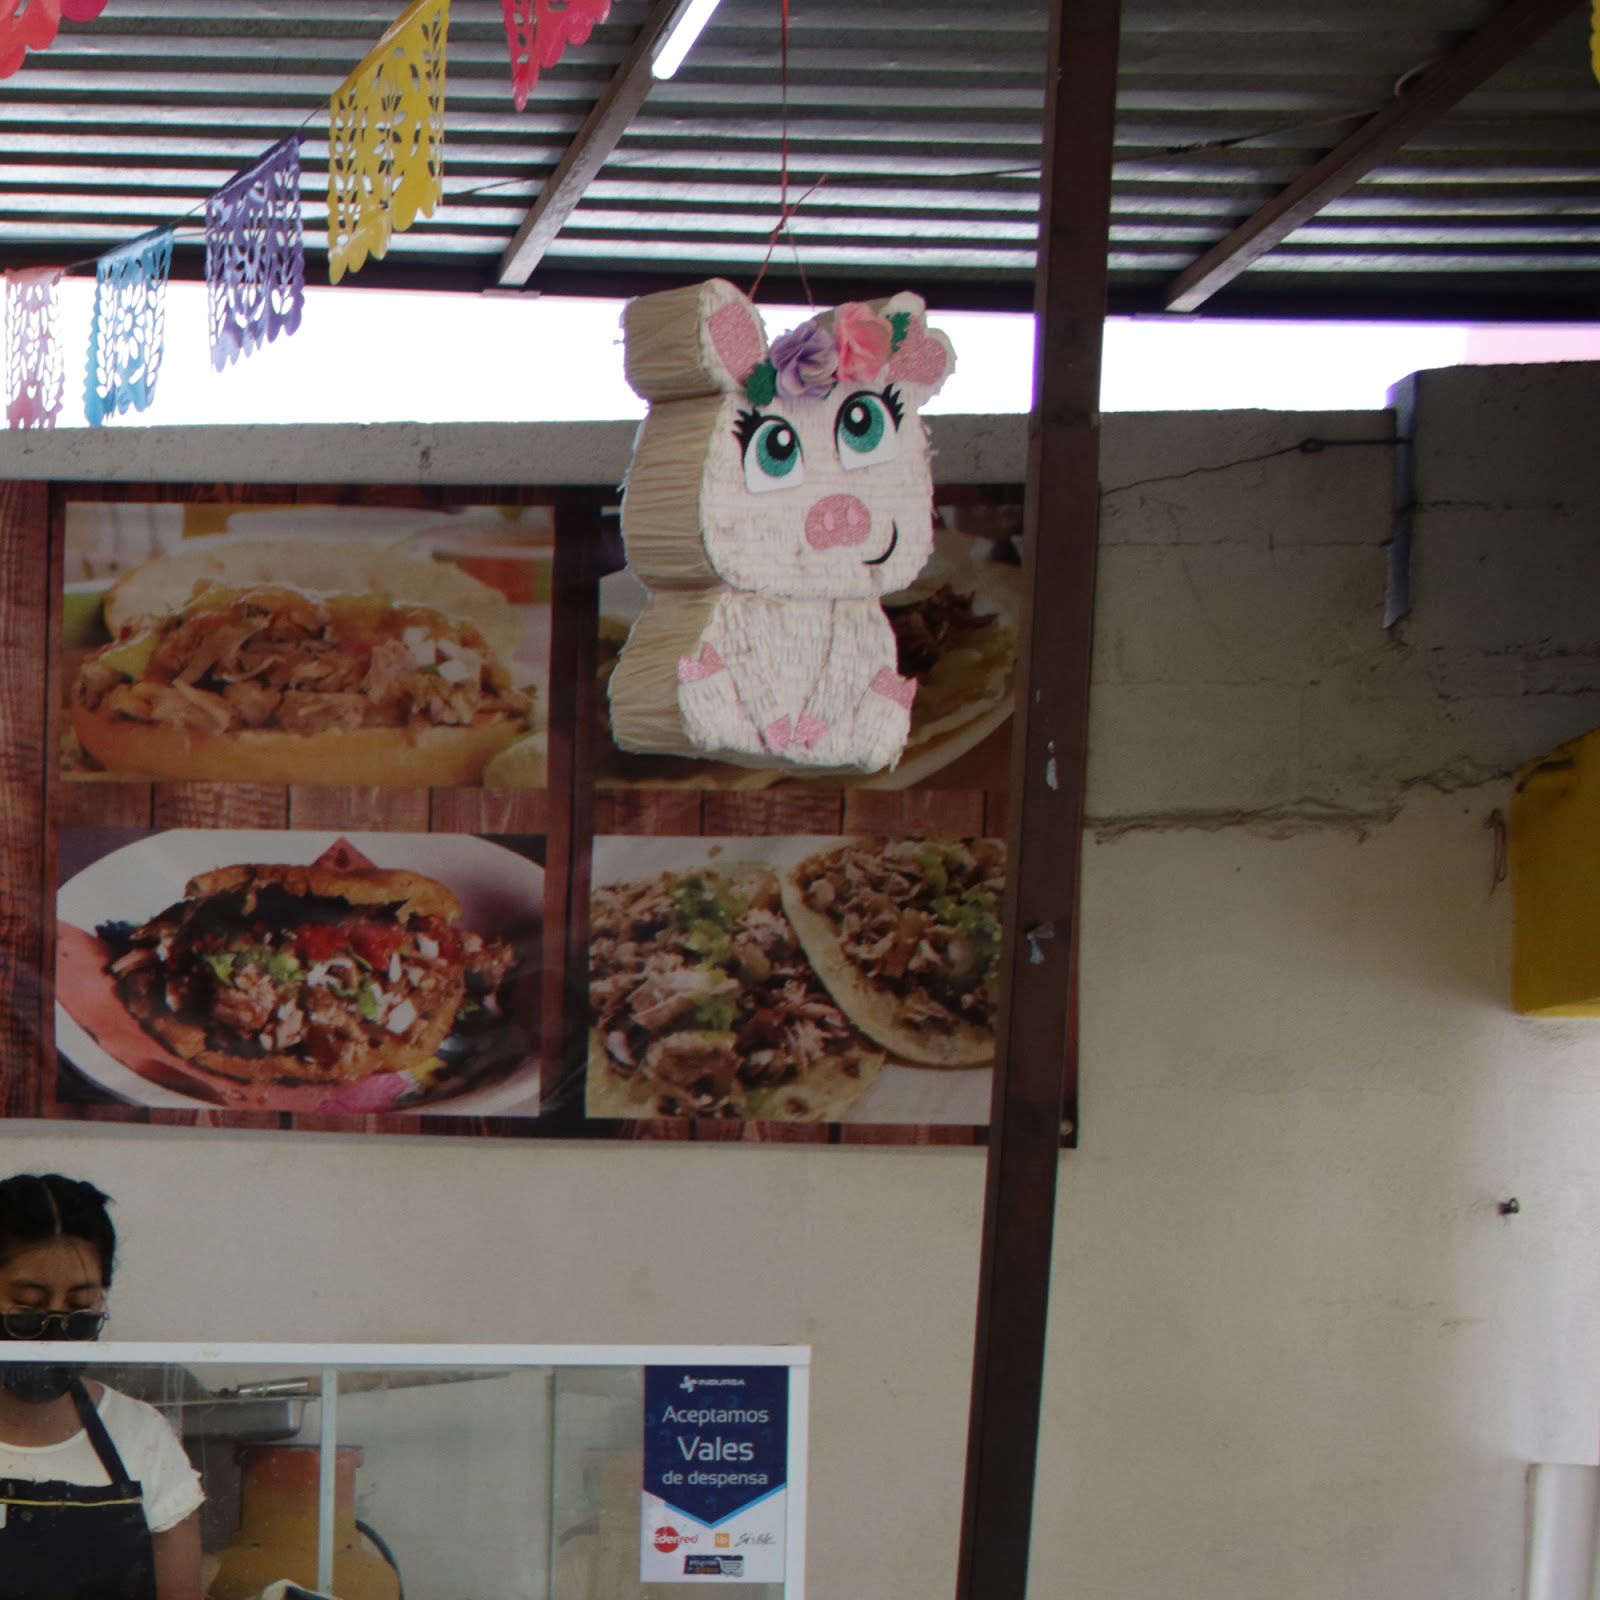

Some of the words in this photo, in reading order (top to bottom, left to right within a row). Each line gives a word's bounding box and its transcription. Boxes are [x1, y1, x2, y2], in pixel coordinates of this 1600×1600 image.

[662, 1405, 769, 1427] Aceptamos
[677, 1435, 754, 1462] Vales
[662, 1470, 683, 1485] de
[688, 1470, 768, 1488] despensa
[652, 1533, 699, 1545] Edenred
